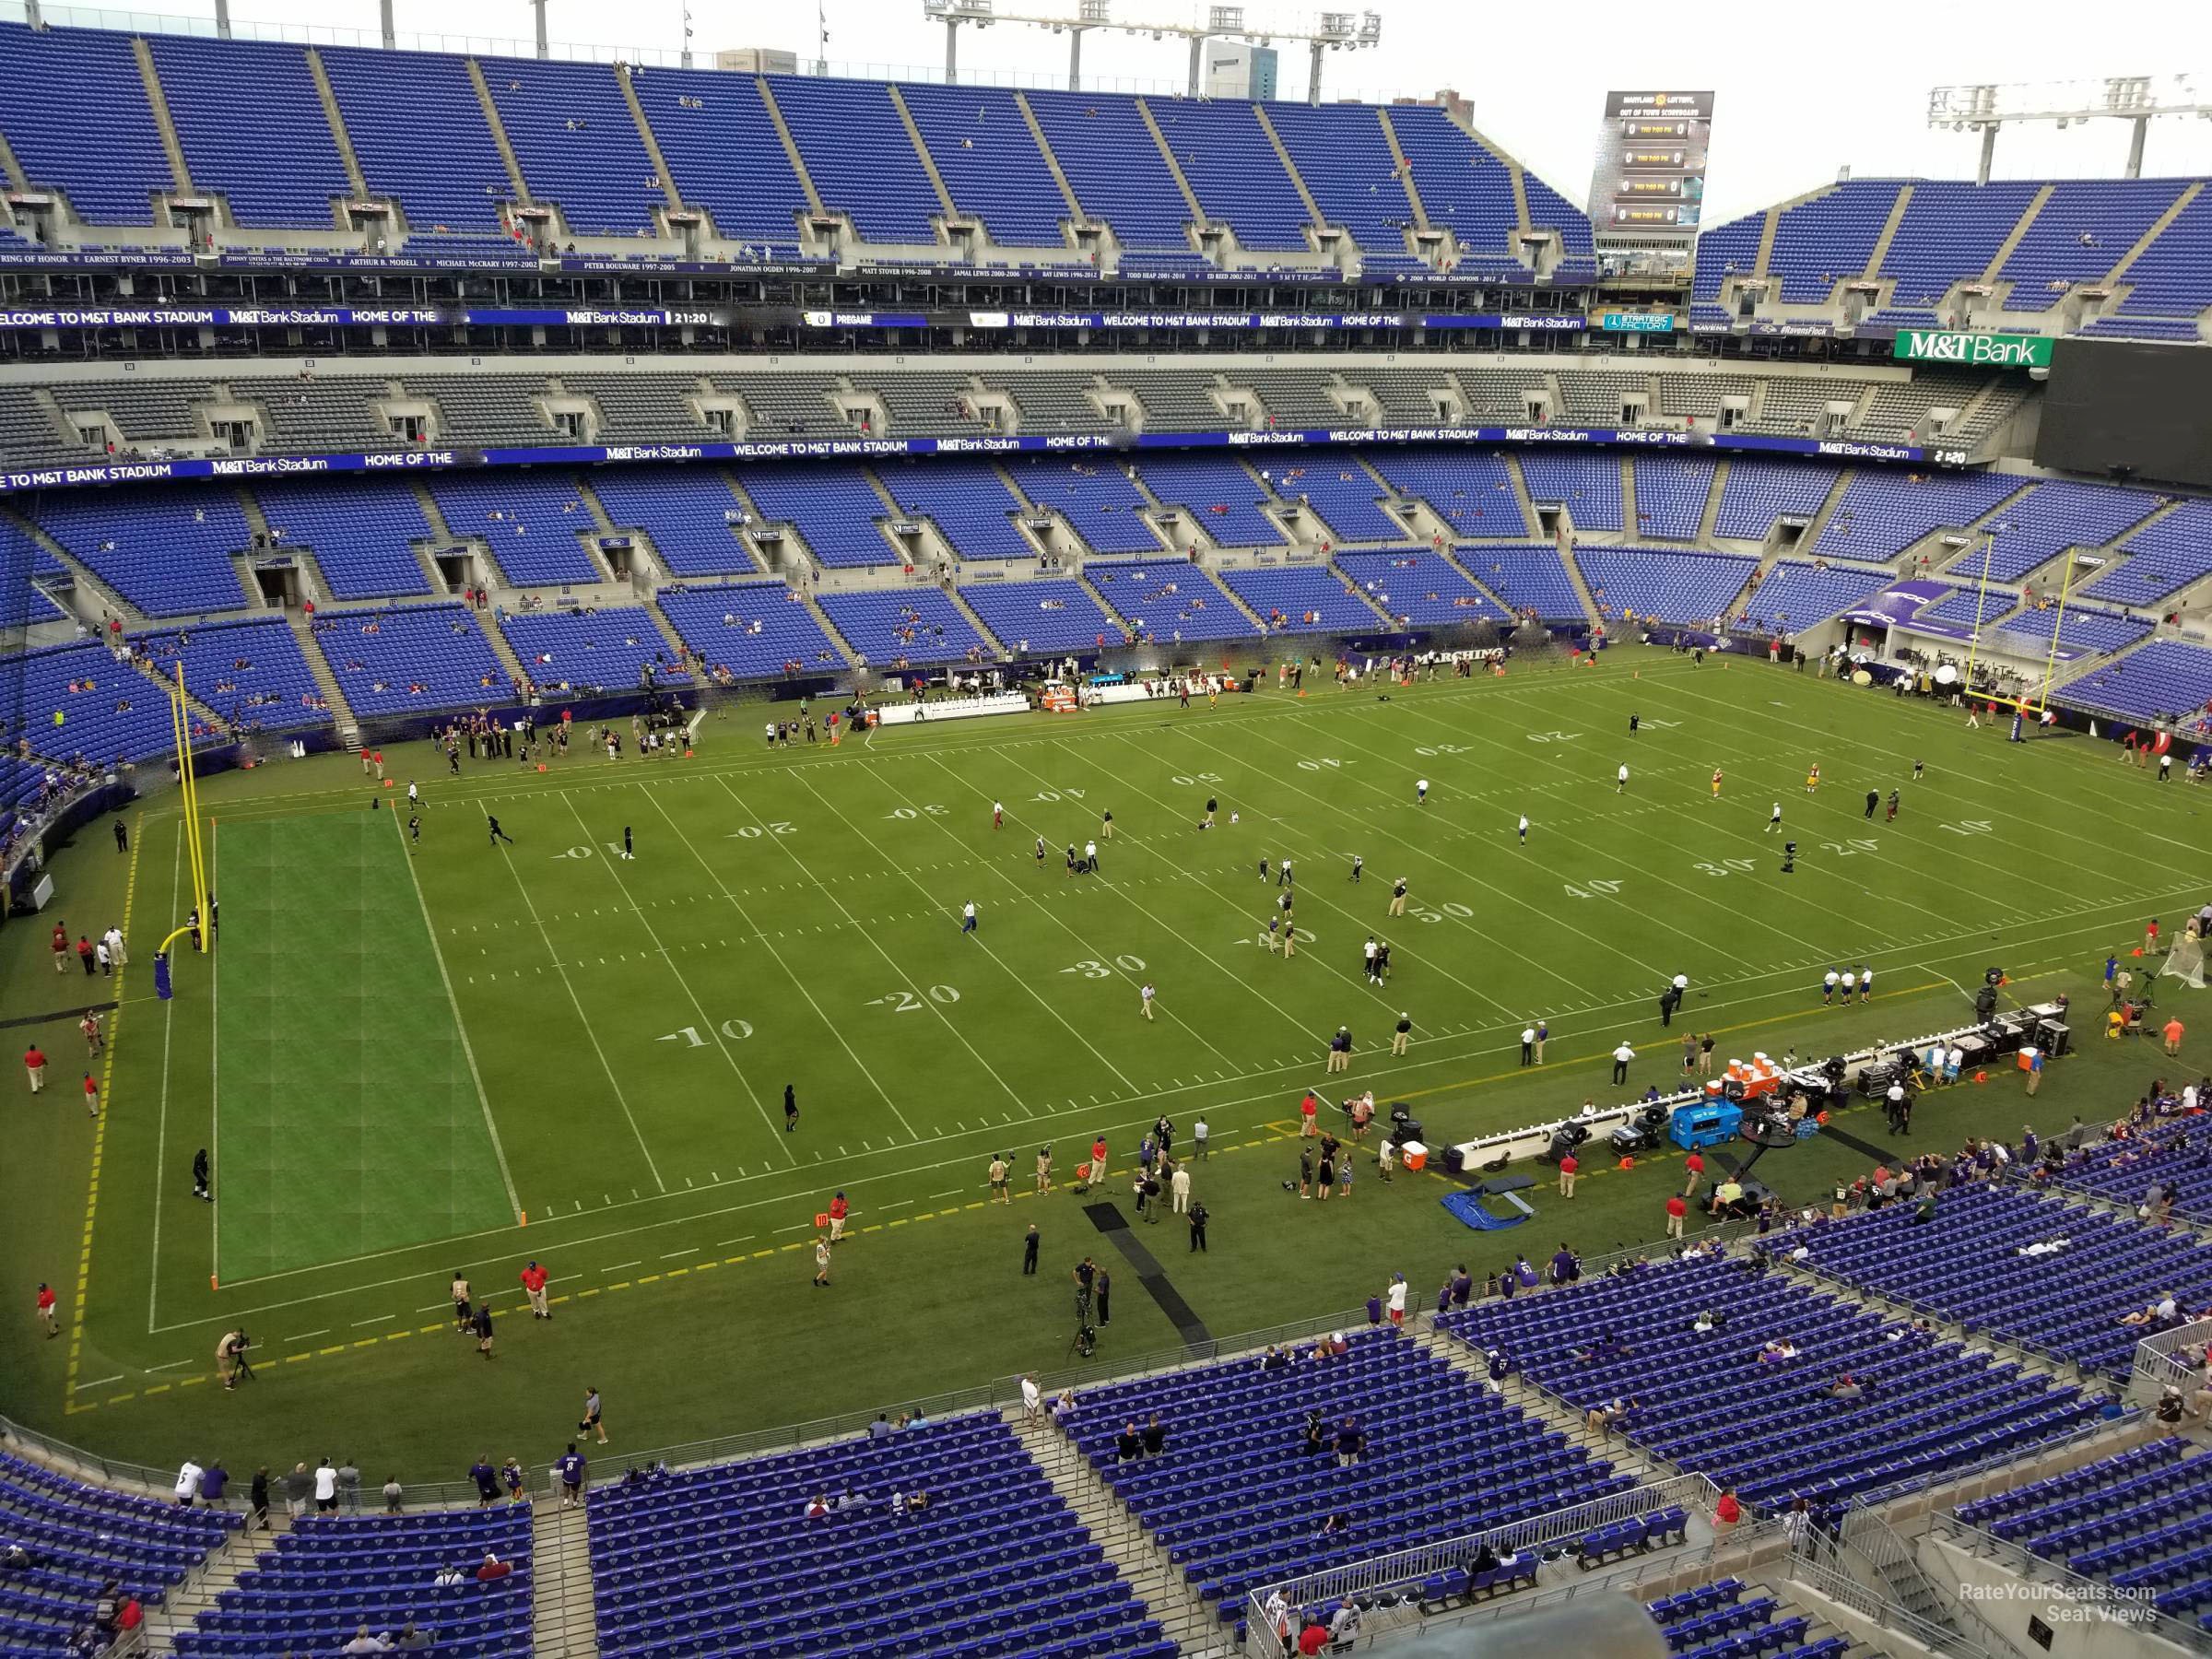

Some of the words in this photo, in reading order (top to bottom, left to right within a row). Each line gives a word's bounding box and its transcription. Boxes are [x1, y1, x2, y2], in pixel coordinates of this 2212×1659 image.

[57, 313, 78, 324] TO
[81, 312, 111, 324] M&T
[114, 312, 150, 323] BANK
[154, 311, 213, 323] STADIUM
[229, 311, 261, 323] M&T
[262, 312, 290, 323] Bank
[291, 311, 338, 323] Stadium
[352, 311, 389, 322] HOME
[391, 311, 410, 322] OF
[412, 312, 436, 322] THE
[566, 312, 593, 324] M&T
[594, 312, 618, 323] Bank
[619, 312, 659, 323] Stadium
[675, 313, 706, 323] 21:20
[836, 315, 872, 324] PREGAME
[1013, 315, 1036, 326] M&T
[1036, 315, 1057, 326] Bank
[1057, 315, 1092, 326] Stadium
[1103, 317, 1148, 326] WELCOME
[1150, 317, 1163, 326] TO
[1165, 317, 1184, 326] M&T
[1186, 317, 1211, 326] BANK
[1212, 317, 1250, 326] STADIUM
[1259, 316, 1280, 327] M&T
[1281, 317, 1300, 327] Bank
[1300, 317, 1332, 327] Stadium
[1342, 316, 1367, 325] HOME
[1369, 316, 1381, 325] OF
[1383, 317, 1400, 325] THE
[1501, 317, 1523, 328] M&T
[1523, 318, 1545, 328] Bank
[1545, 318, 1580, 329] Stadium
[1780, 327, 1827, 336] #RavensFlock
[1907, 332, 1975, 360] M&T
[1973, 335, 2037, 364] Bank
[1228, 433, 1251, 444] M&T
[1250, 433, 1271, 443] Bank
[1271, 432, 1304, 443] Stadium
[1330, 431, 1375, 441] WELCOME
[1377, 431, 1389, 440] TO
[1390, 430, 1409, 440] M&T
[1411, 429, 1436, 439] BANK
[1438, 429, 1479, 439] STADIUM
[1506, 429, 1529, 440] M&T
[1529, 430, 1551, 440] Bank
[1551, 430, 1588, 441] Stadium
[1616, 432, 1647, 442] HOME
[1649, 432, 1665, 442] OF
[1666, 433, 1686, 443] THE
[936, 440, 961, 451] M&T
[961, 440, 983, 450] Bank
[984, 439, 1019, 450] Stadium
[1047, 436, 1075, 447] HOME
[1077, 436, 1091, 446] OF
[606, 447, 634, 459] M&T
[635, 447, 660, 459] Bank
[660, 446, 701, 459] Stadium
[734, 444, 789, 456] WELCOME
[791, 444, 806, 454] TO
[808, 443, 831, 453] M&T
[833, 442, 862, 453] BANK
[863, 441, 908, 453] STADIUM
[1819, 442, 1845, 454] M&T
[1845, 444, 1870, 455] Bank
[1869, 446, 1909, 459] Stadium
[365, 454, 404, 466] HOME
[406, 453, 424, 465] OF
[427, 453, 453, 464] THE
[212, 461, 246, 474] M&T
[246, 460, 277, 473] Bank
[278, 458, 327, 471] Stadium
[9, 474, 30, 487] TO
[33, 471, 64, 485] M&T
[67, 469, 107, 482] BANK
[109, 465, 171, 479] STADIUM
[1946, 536, 1971, 544] GEICO
[2079, 555, 2106, 565] GEICO
[1171, 772, 1225, 786] 50
[737, 821, 798, 839] 20
[1819, 838, 1878, 856] 20
[1693, 858, 1755, 877] 30
[1564, 879, 1619, 900] 40
[1408, 902, 1474, 923] 50
[1075, 954, 1147, 979] 30
[885, 983, 961, 1013] 20
[677, 1018, 754, 1049] 10
[1404, 1153, 1412, 1165] G
[1625, 1158, 1633, 1169] 40
[1081, 1165, 1088, 1177] 20
[818, 1215, 827, 1225] 10
[567, 1462, 574, 1471] 8
[179, 1472, 188, 1484] 5
